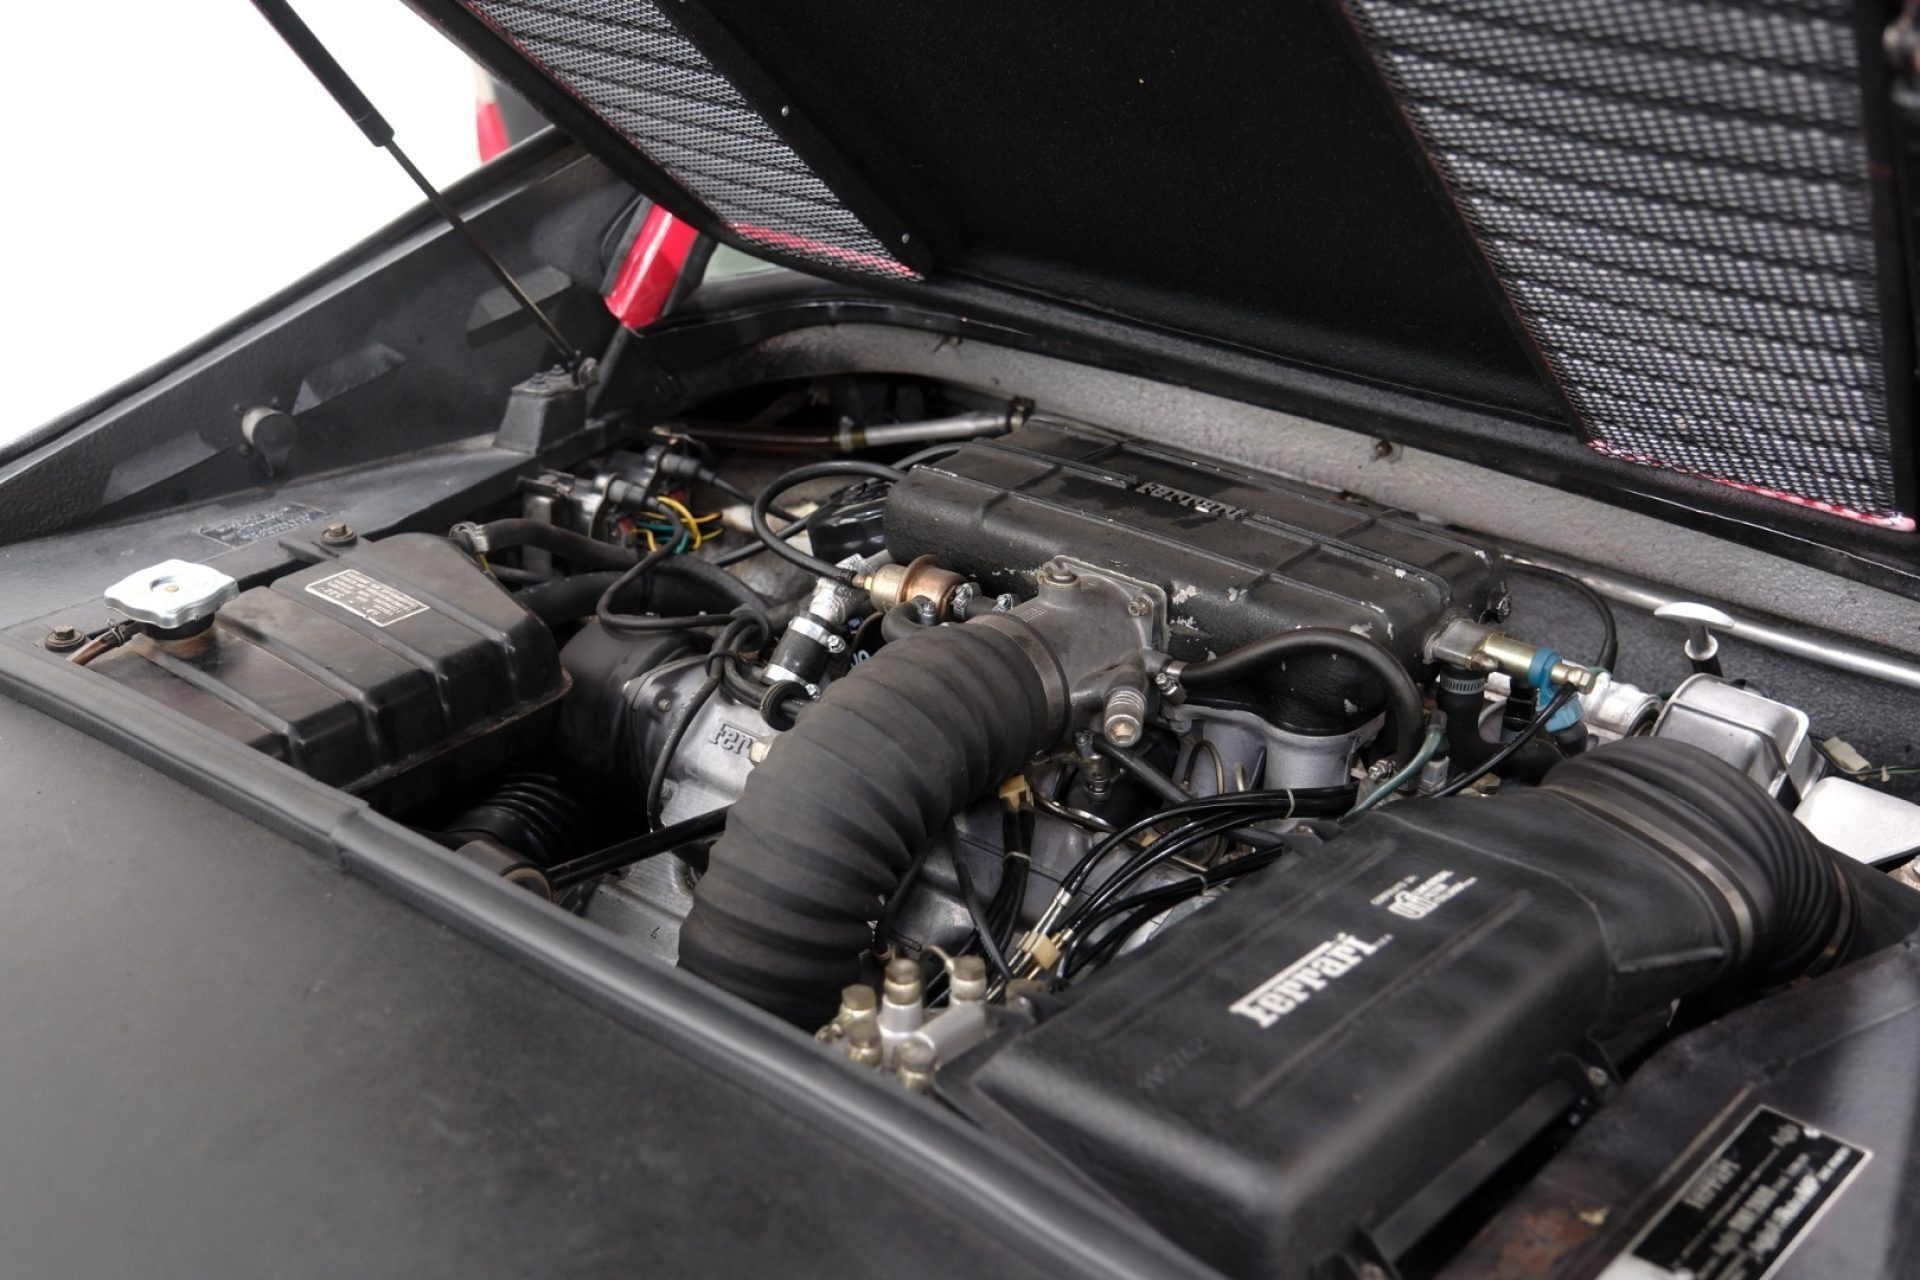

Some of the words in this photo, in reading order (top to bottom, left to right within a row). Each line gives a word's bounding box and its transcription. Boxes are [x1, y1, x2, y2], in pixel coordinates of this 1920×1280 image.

[1135, 482, 1248, 520] Ferrari
[708, 720, 757, 755] Fer
[1228, 932, 1379, 1029] Ferrari
